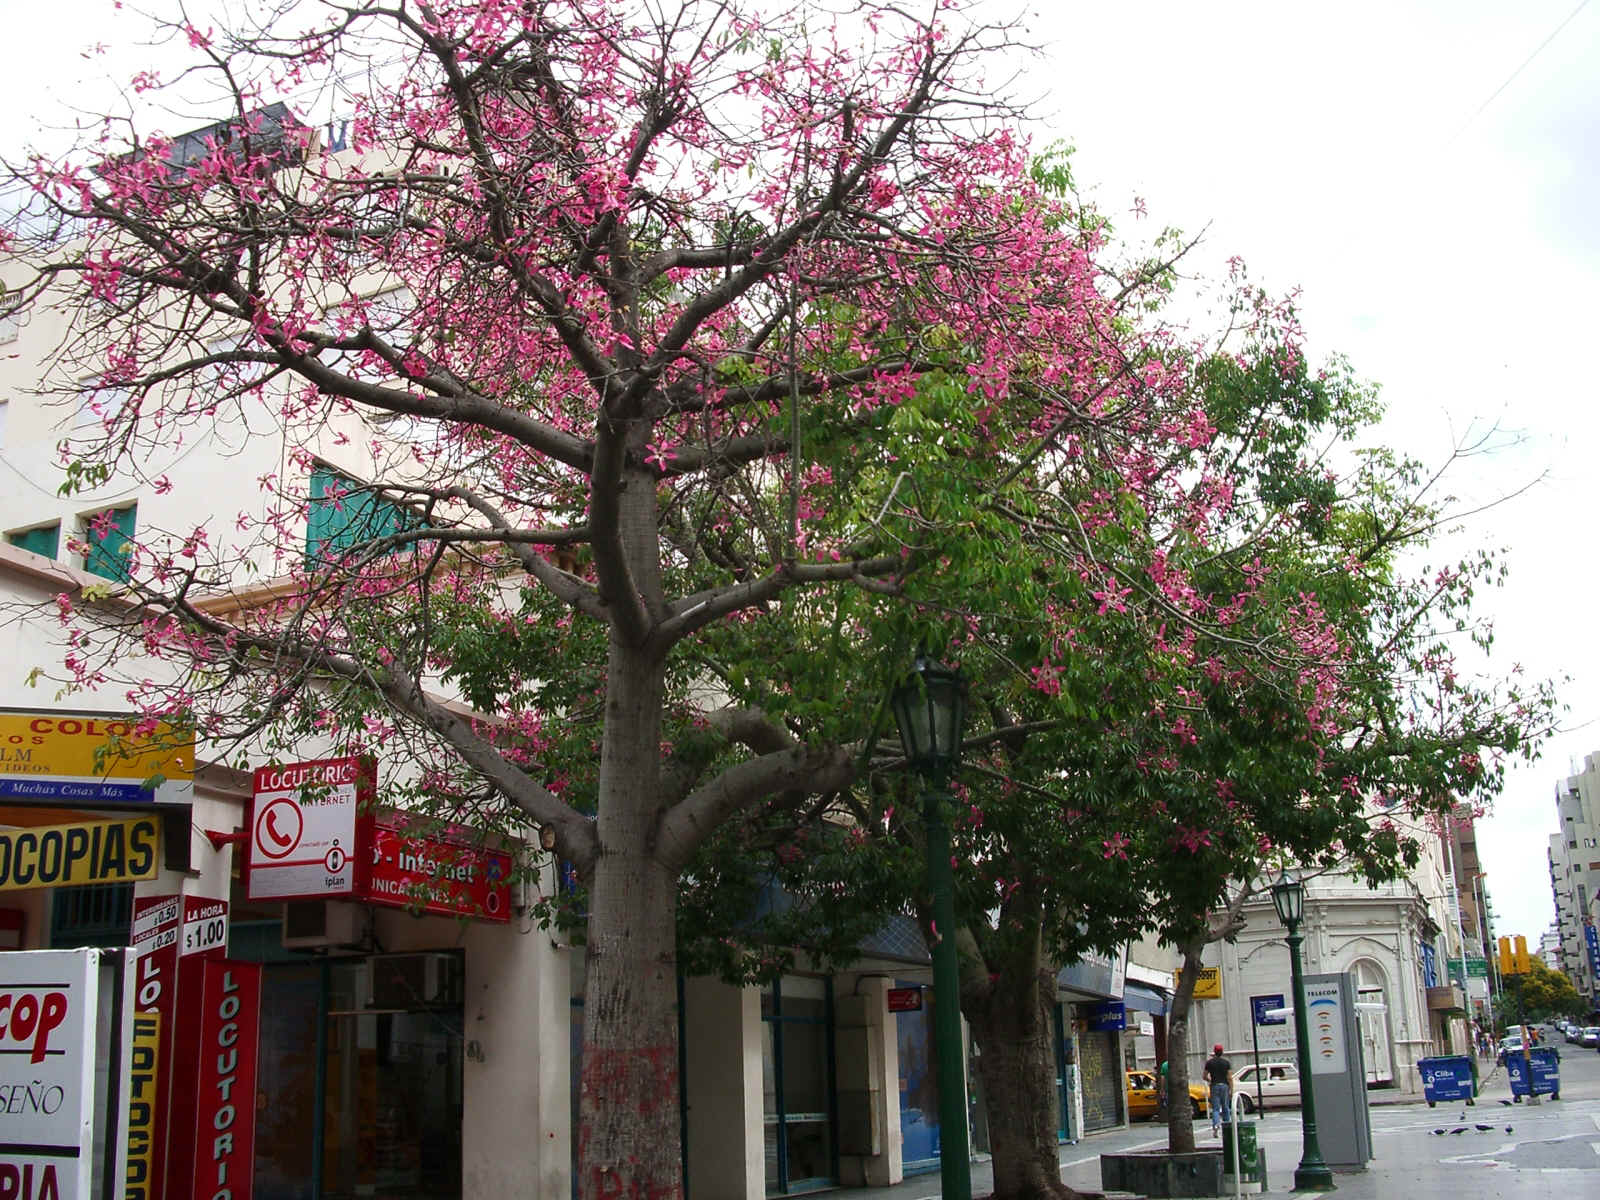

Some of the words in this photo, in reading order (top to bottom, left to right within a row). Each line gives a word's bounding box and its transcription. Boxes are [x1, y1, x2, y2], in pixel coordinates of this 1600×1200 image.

[11, 783, 55, 795] Muchas
[61, 785, 95, 796] Cosas
[304, 795, 351, 807] NTERNET
[325, 877, 344, 888] iplan
[187, 910, 198, 921] LA
[201, 904, 223, 919] HORA
[140, 957, 161, 1013] LO
